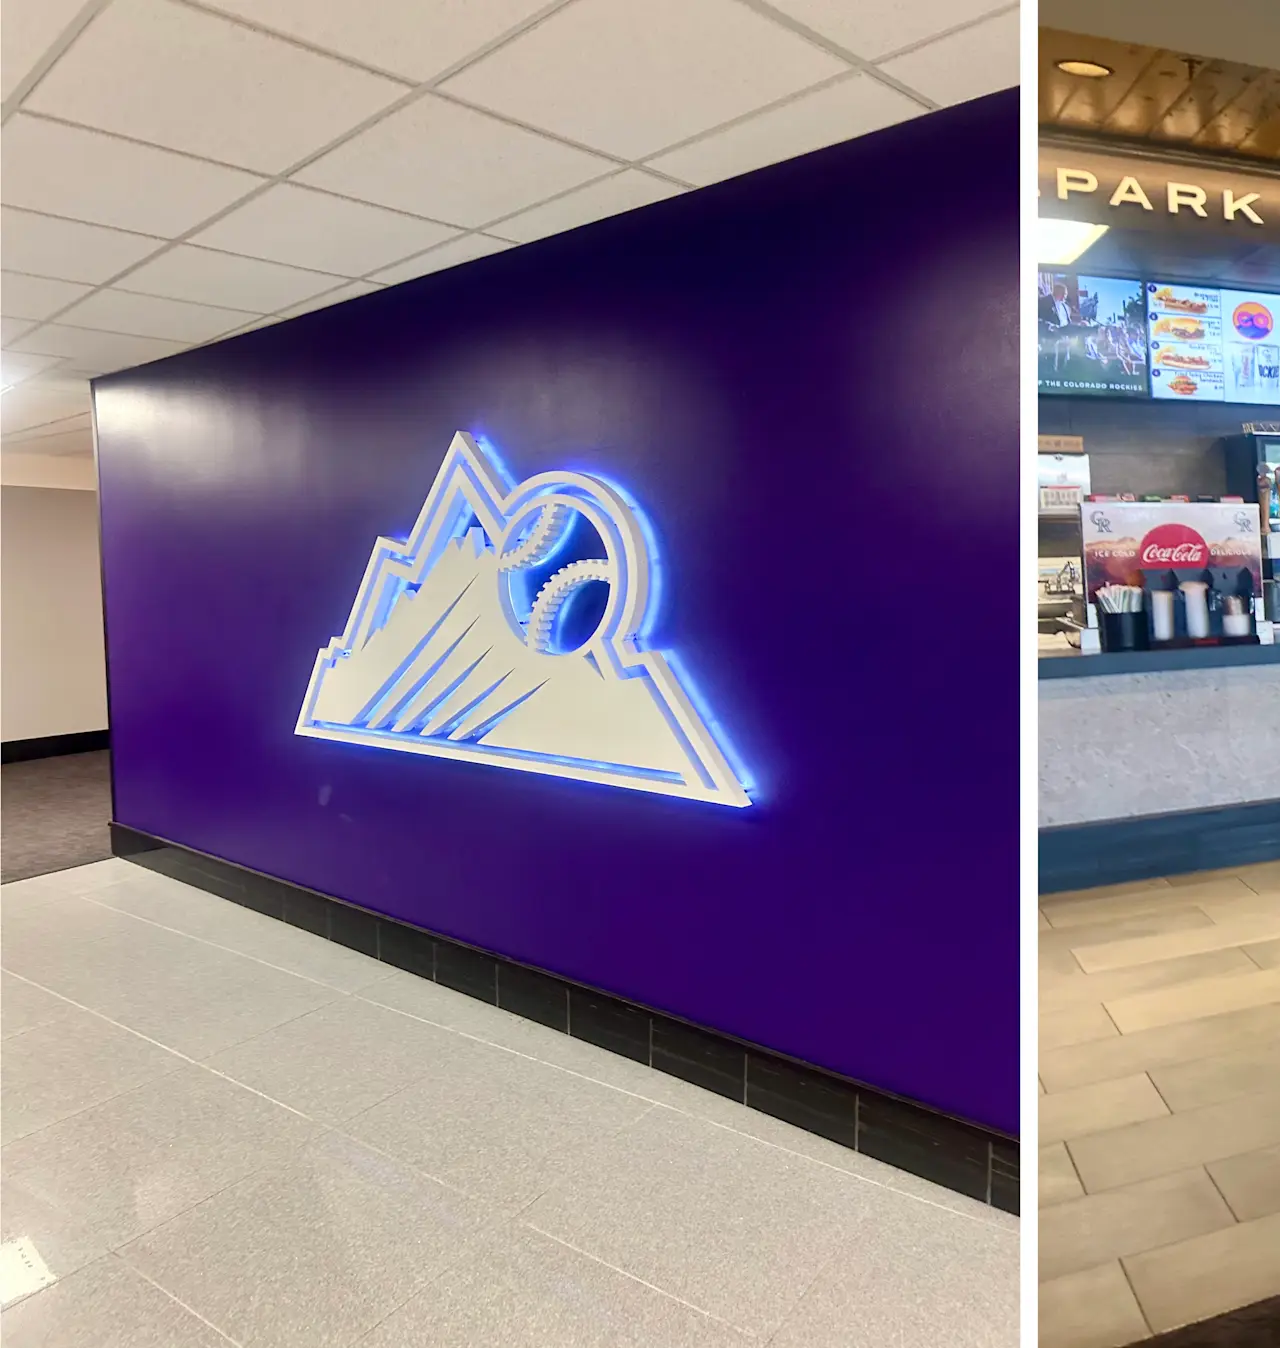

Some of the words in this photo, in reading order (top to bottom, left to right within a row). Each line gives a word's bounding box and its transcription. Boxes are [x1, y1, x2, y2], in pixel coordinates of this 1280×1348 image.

[1038, 167, 1264, 225] PARK
[1045, 379, 1061, 387] THE
[1063, 380, 1107, 390] COLORADO
[1109, 382, 1143, 392] ROCKIES
[1094, 550, 1109, 558] ICE
[1112, 550, 1136, 558] COLD
